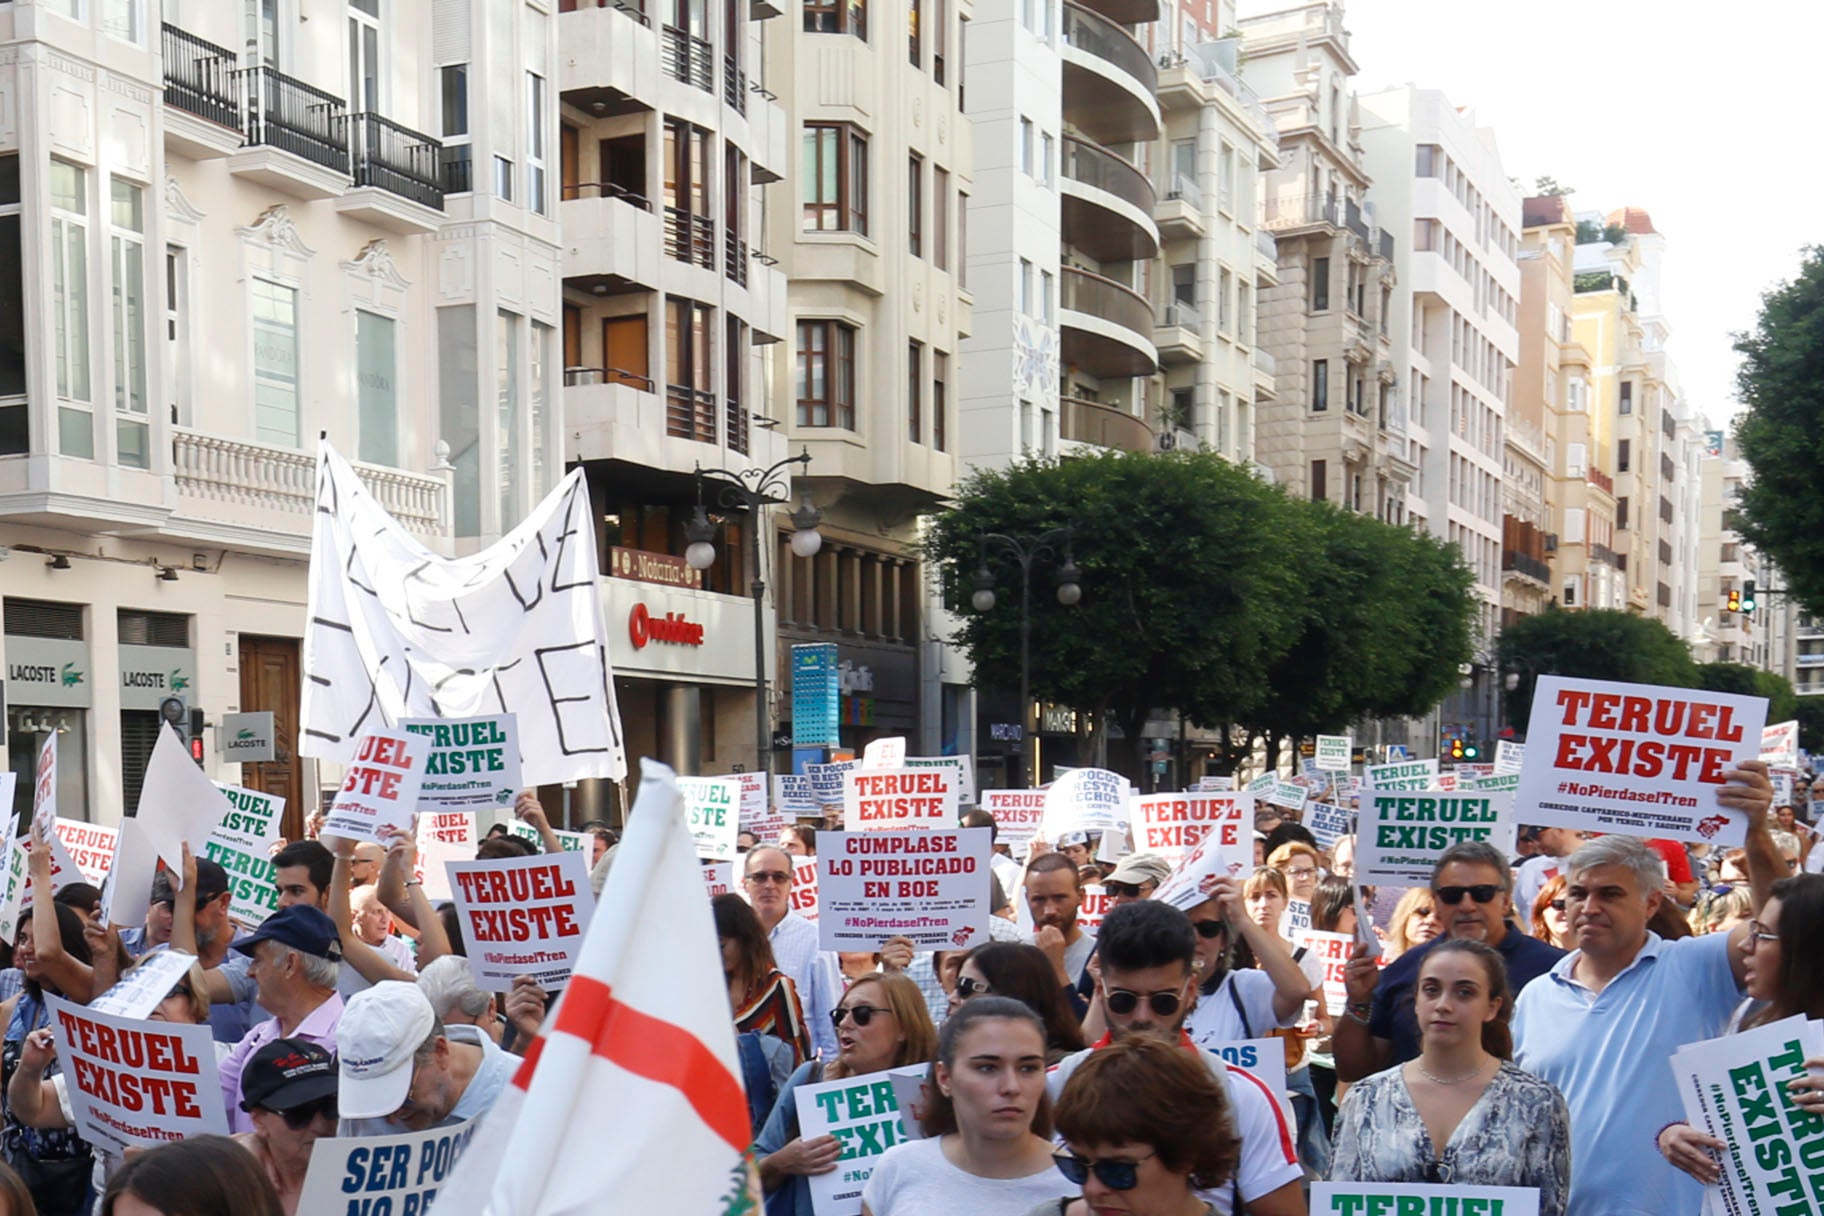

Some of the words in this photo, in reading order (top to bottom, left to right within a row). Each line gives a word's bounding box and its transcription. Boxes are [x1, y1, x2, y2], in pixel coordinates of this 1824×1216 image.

[10, 664, 56, 683] LACOSTE
[123, 671, 164, 688] LACOSTE
[1556, 690, 1744, 743] TERUEL
[228, 738, 266, 749] LACOSTE
[425, 748, 504, 774] XISTE
[1553, 733, 1733, 785] EXISTE
[1371, 764, 1430, 781] TERUEL
[1476, 774, 1520, 788] TERUE
[855, 774, 947, 796] TERUEL
[1557, 782, 1697, 807] #NoPierdaselTren
[860, 798, 943, 820] EXISTE
[990, 794, 1045, 807] TERUE
[1140, 799, 1242, 822] TERUEL
[1374, 797, 1498, 823] TERUEL
[992, 810, 1042, 823] EXIST
[55, 824, 117, 852] TERUEL
[846, 833, 957, 854] CÚMPLASE
[206, 841, 277, 884] TERUE
[828, 860, 852, 876] LO
[861, 857, 975, 876] PUBLICADO
[456, 865, 576, 904] TERUEL
[864, 882, 890, 898] EN
[898, 880, 939, 897] BOE
[469, 904, 580, 942] EXISTE
[845, 917, 948, 928] #NoPierdaselTren
[57, 1009, 200, 1074] TERUEL
[72, 1055, 202, 1118] EXISTE
[341, 1144, 411, 1193] SER
